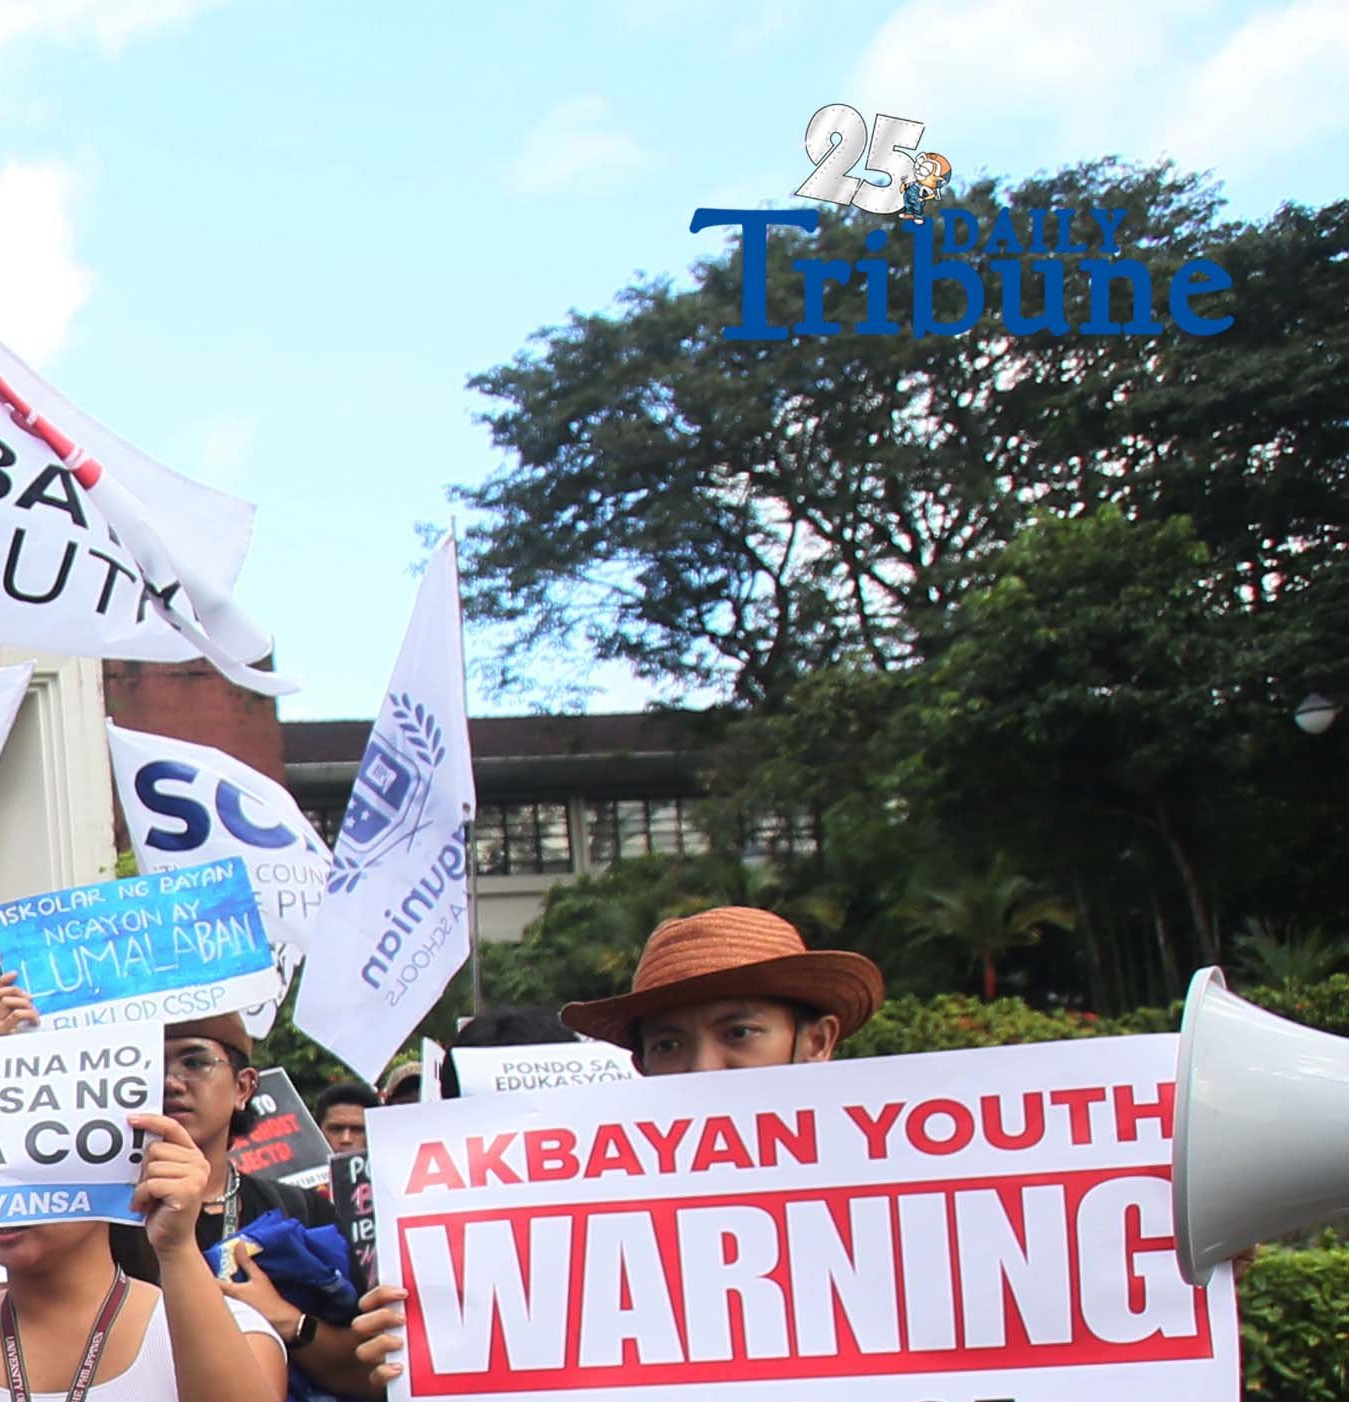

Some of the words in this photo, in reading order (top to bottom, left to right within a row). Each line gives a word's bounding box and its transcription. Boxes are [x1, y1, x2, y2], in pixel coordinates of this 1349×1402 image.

[117, 879, 151, 900] NG
[159, 861, 236, 896] BAYAN
[172, 898, 202, 922] AY
[4, 1054, 68, 1079] INA
[79, 1046, 152, 1072] MO,
[502, 1060, 583, 1075] PONDO
[590, 1058, 620, 1072] SA
[75, 1076, 149, 1110] NG
[25, 1119, 146, 1165] CO!
[403, 1108, 820, 1195] AKBAYAN
[845, 1081, 1177, 1161] YOUTH
[406, 1175, 1199, 1376] WARNING
